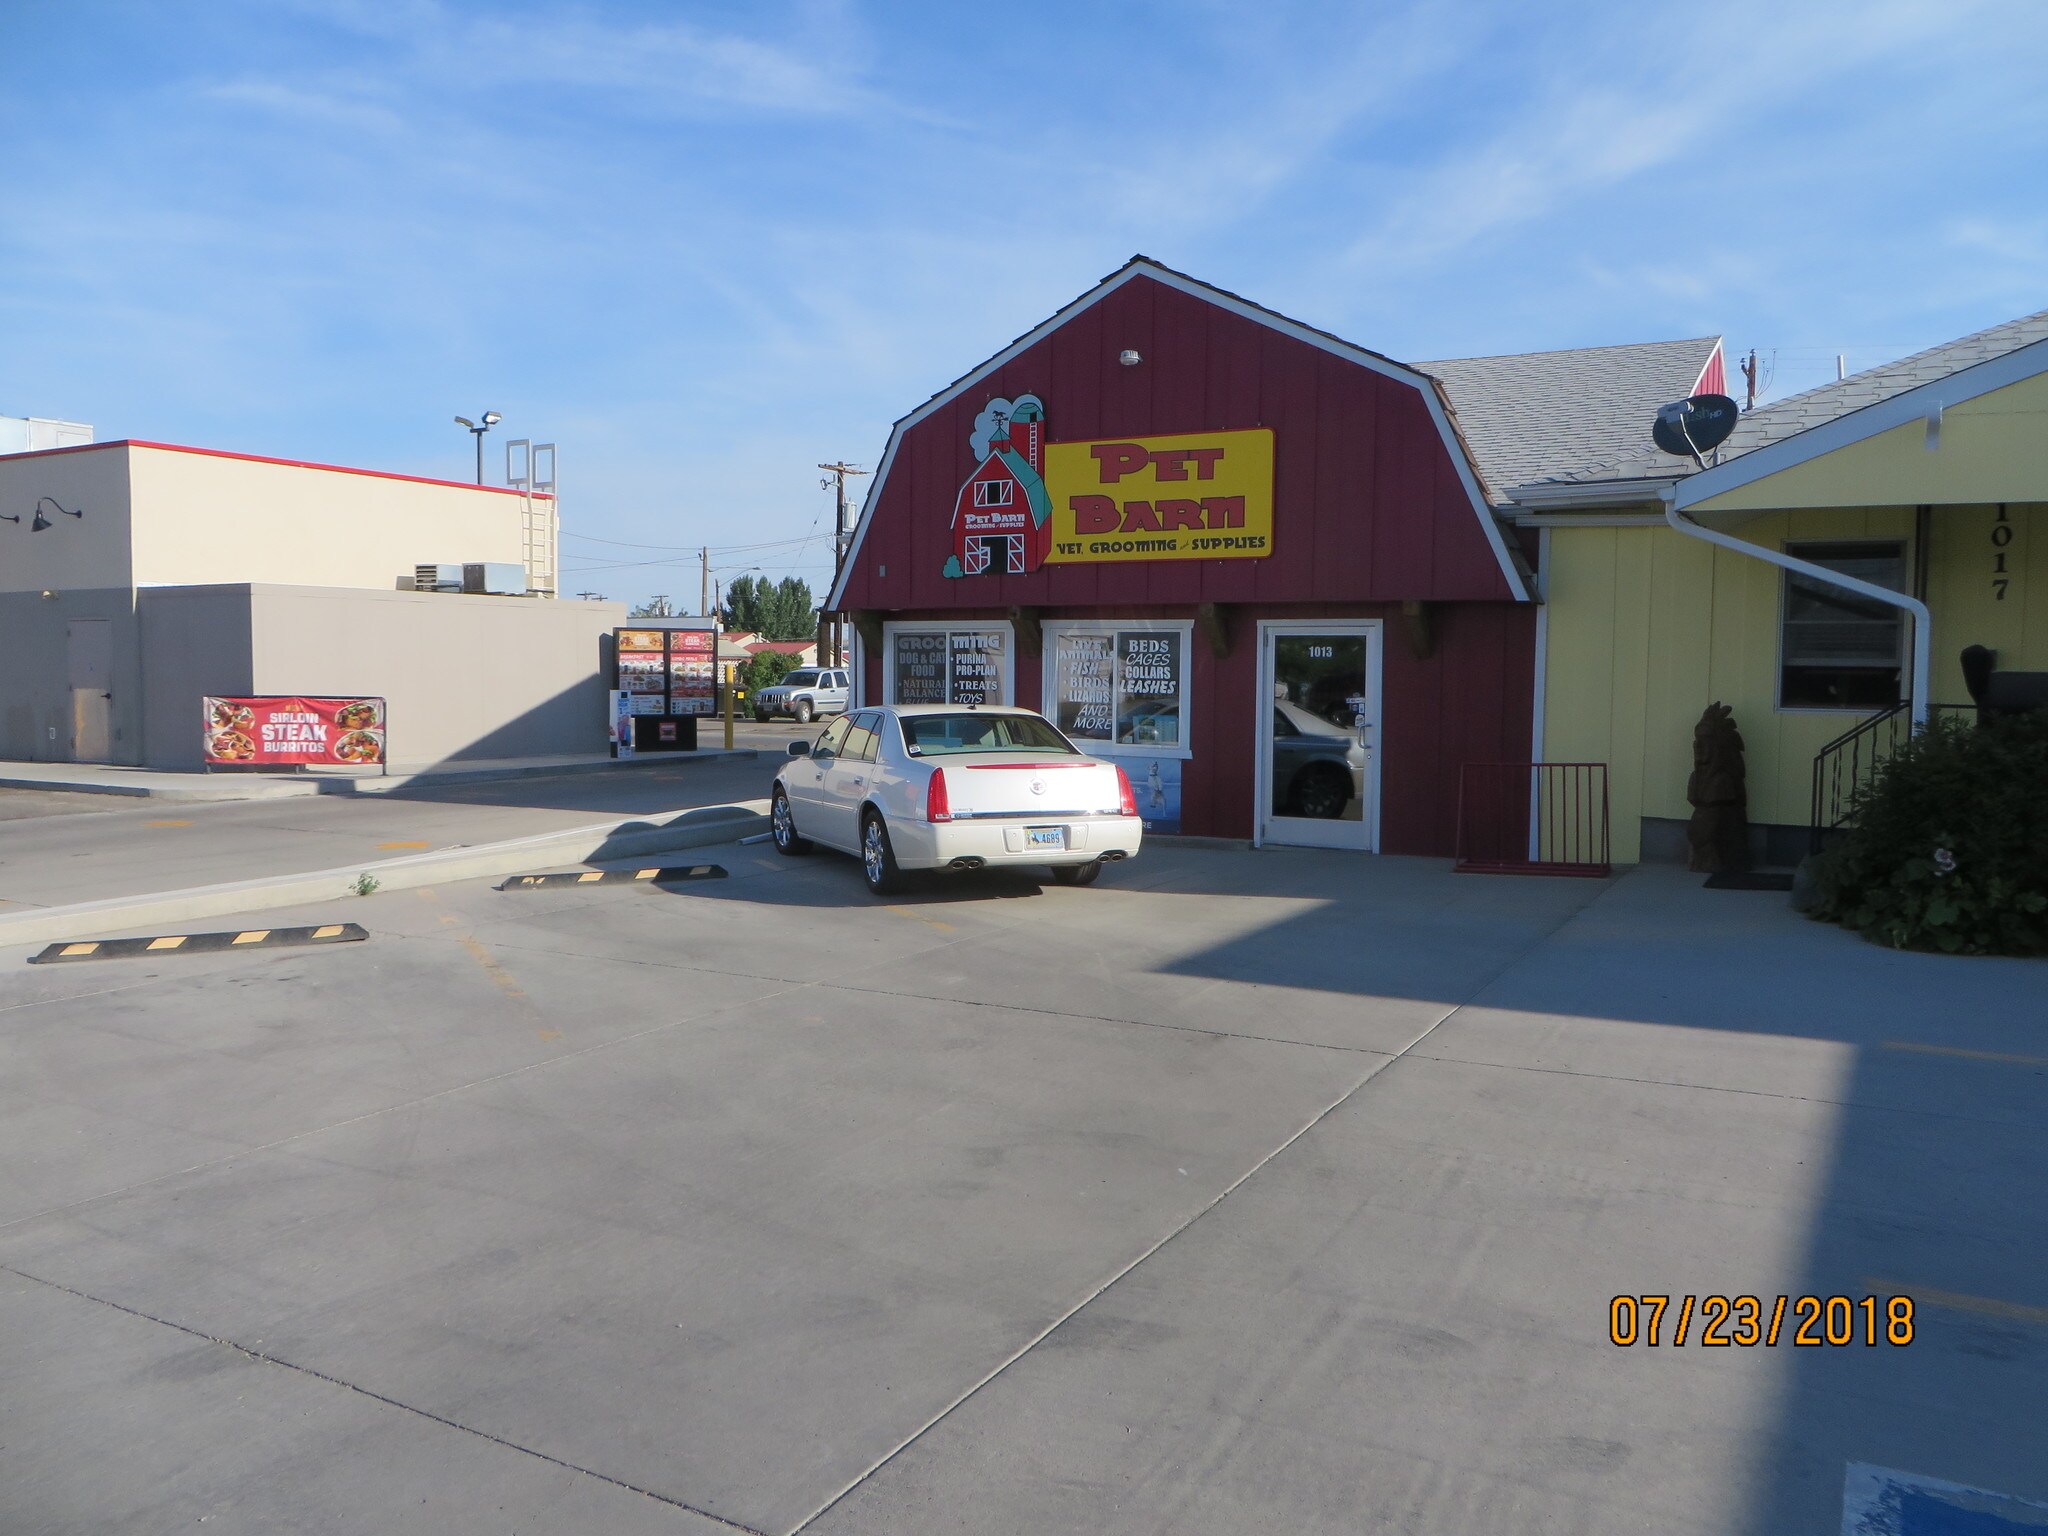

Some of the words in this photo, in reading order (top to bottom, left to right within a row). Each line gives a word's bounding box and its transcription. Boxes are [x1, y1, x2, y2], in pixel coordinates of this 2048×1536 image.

[1090, 443, 1225, 483] PET
[964, 514, 990, 524] PET
[991, 512, 1026, 523] BARN
[1069, 495, 1246, 535] BARN
[1089, 539, 1177, 554] GROOMING
[1191, 536, 1266, 551] SUPPLIES
[1991, 503, 2013, 601] 1017
[1072, 639, 1102, 650] LIVE
[1128, 639, 1169, 653] BEDS
[899, 652, 919, 665] DOG
[921, 654, 928, 665] &
[929, 652, 946, 665] CAT
[1309, 646, 1333, 658] 1013
[956, 653, 987, 665] PURINA
[1126, 653, 1171, 666] CAGES
[911, 665, 935, 677] FOOD
[956, 664, 997, 676] PRO-PLAN
[1070, 662, 1099, 675] FISH
[1125, 666, 1171, 680] COLLARS
[959, 681, 998, 690] TREATS
[1070, 677, 1110, 688] BIRDS
[1119, 680, 1177, 695] LEASHES
[903, 688, 946, 698] BALANCE
[958, 693, 983, 704] TOYS
[1068, 689, 1110, 703] LIZARDS
[1077, 704, 1109, 717] AND
[270, 712, 319, 723] SIRLOIN
[1072, 717, 1112, 730] MORE
[261, 724, 328, 741] STEAK
[264, 741, 325, 752] BURRITOS
